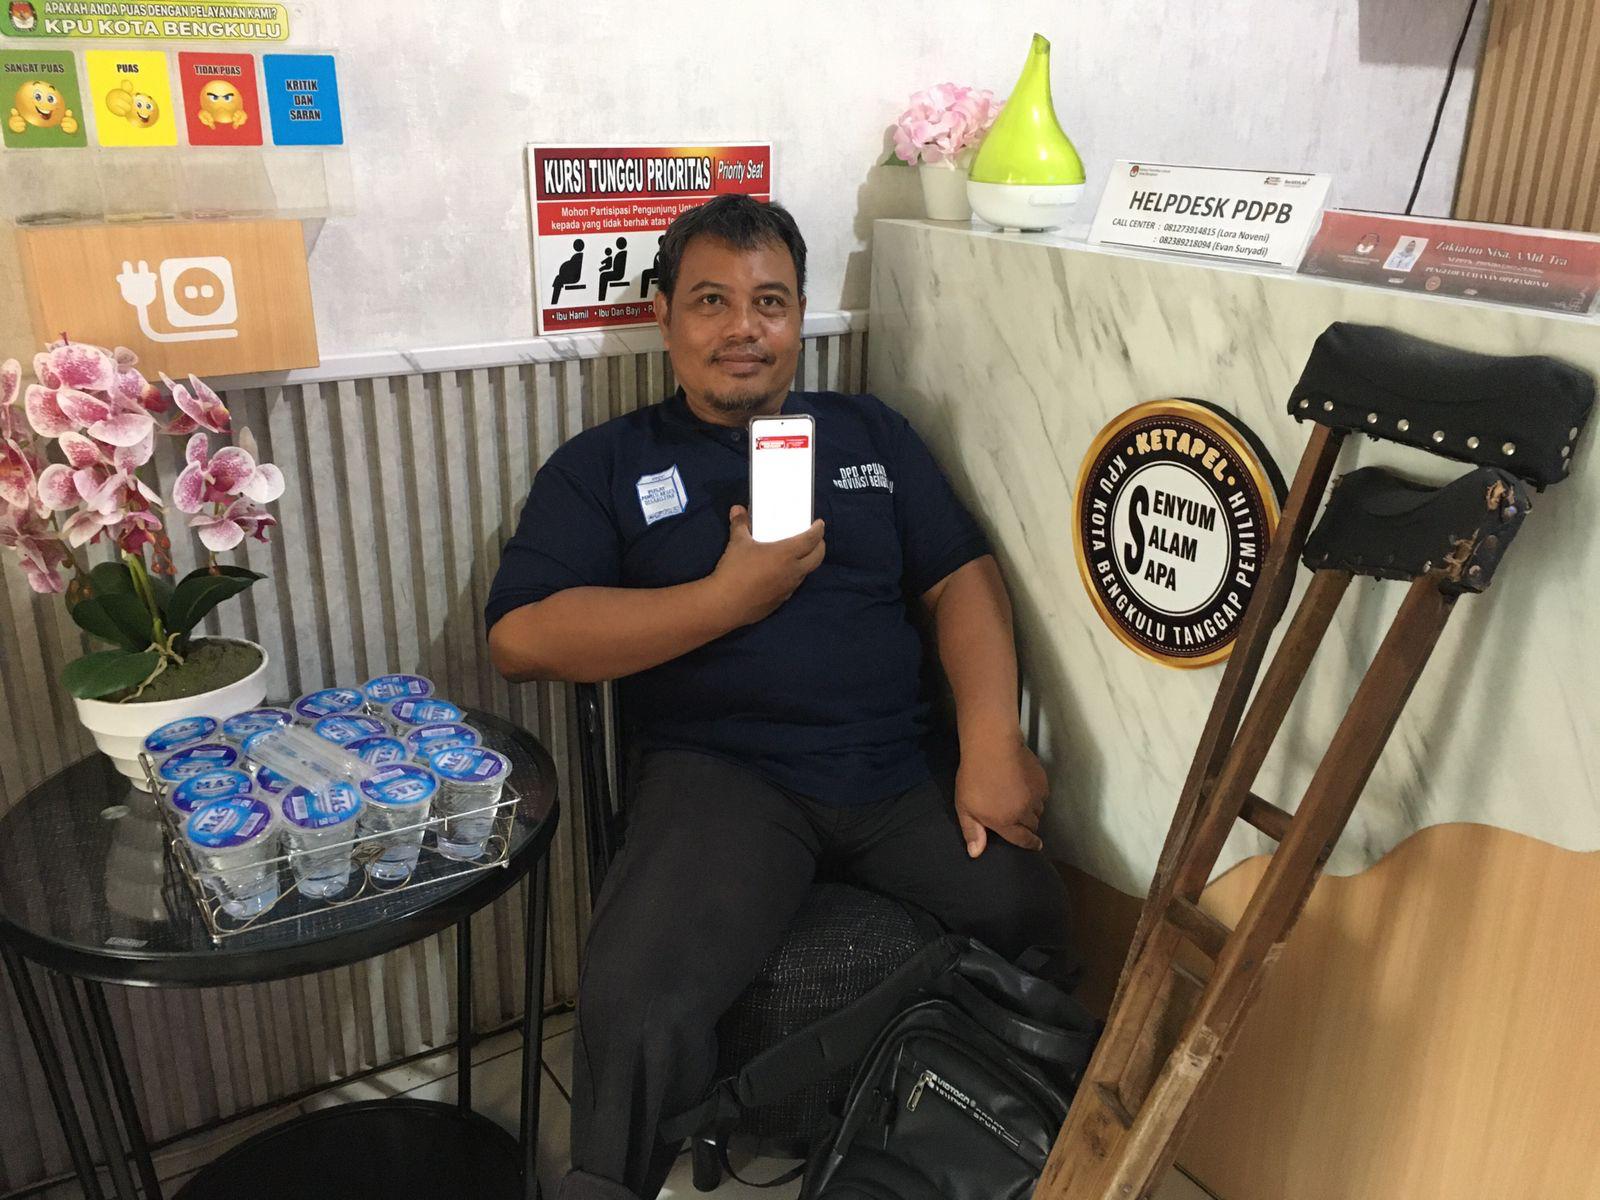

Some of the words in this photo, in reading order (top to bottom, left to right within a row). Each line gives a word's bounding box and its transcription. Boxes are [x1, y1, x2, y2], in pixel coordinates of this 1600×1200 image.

[45, 3, 89, 15] APAKAH
[90, 4, 119, 16] ANDA
[120, 5, 147, 16] PUAS
[149, 5, 189, 17] DENGAN
[190, 6, 246, 18] PELAYANAN
[247, 7, 278, 19] KAMI?
[45, 19, 93, 34] KPU
[99, 20, 160, 35] KOTA
[164, 22, 281, 38] BENGKULU
[4, 63, 39, 74] SANGAT
[41, 64, 64, 74] PUAS
[116, 63, 139, 73] PUAS
[195, 65, 218, 75] TIDAK
[219, 65, 241, 75] PUAS
[286, 80, 318, 91] KRITIK
[294, 95, 313, 106] DAN
[290, 109, 320, 120] SARAN
[543, 158, 586, 194] KURSI
[589, 157, 644, 193] TUNGGU
[647, 156, 711, 191] PRIORITAS
[717, 160, 745, 184] Priority
[747, 160, 764, 179] Seat
[561, 206, 588, 217] Mohon
[591, 205, 630, 217] Partisipasi
[633, 203, 676, 216] Pengunjung
[1129, 190, 1230, 218] HELPDESK
[1232, 200, 1293, 224] PDPB
[551, 219, 580, 231] kepada
[582, 219, 600, 230] yang
[603, 218, 621, 228] tidak
[624, 217, 649, 228] berhak
[651, 217, 666, 226] atas
[1112, 218, 1127, 227] CALL
[1129, 219, 1156, 229] CENTER
[1217, 227, 1238, 239] (Lora
[1239, 231, 1270, 243] Noveni)
[1212, 241, 1234, 252] (Evan
[1235, 244, 1269, 258] Suryadi)
[556, 311, 567, 320] Ibu
[570, 310, 589, 319] Hamil
[599, 309, 609, 317] Ibu
[611, 307, 624, 316] Dan
[626, 306, 640, 317] Bayi
[1135, 428, 1228, 482] KETAPEL
[1099, 454, 1128, 495] KPU
[1091, 498, 1108, 551] KOTA
[1228, 491, 1256, 588] PEMILIH
[1097, 562, 1166, 641] BENGKULU
[1173, 591, 1243, 646] TANGGAP
[196, 776, 238, 790] MAS
